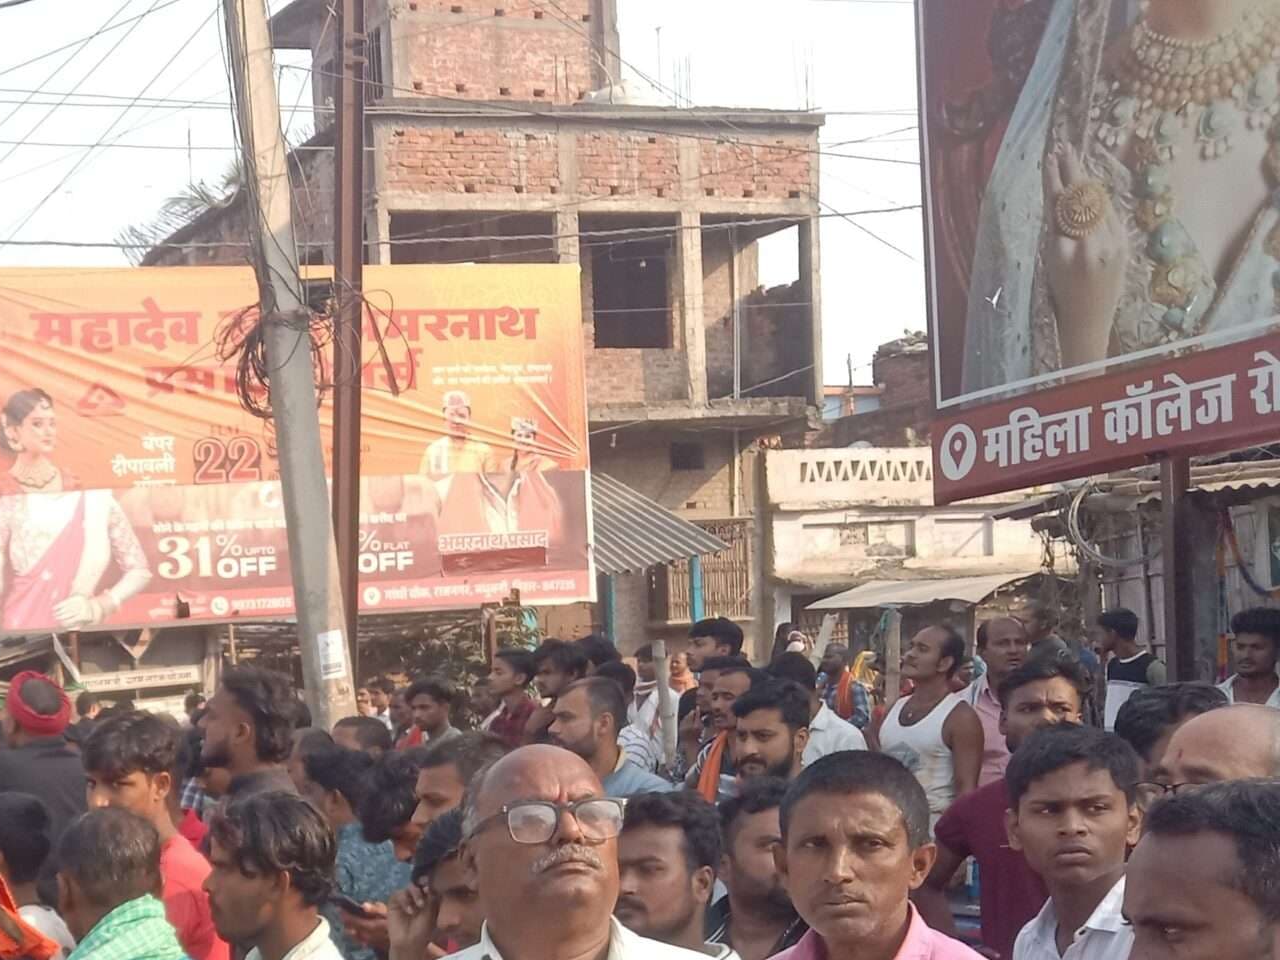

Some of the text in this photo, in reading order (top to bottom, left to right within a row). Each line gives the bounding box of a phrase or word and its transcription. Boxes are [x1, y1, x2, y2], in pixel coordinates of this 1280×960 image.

[30, 297, 202, 353] महादेव
[982, 350, 1280, 468] महिला कॉलेज रो
[193, 437, 262, 484] 22
[244, 547, 276, 556] UPTO
[383, 541, 410, 551] FLAT
[216, 556, 277, 579] OFF
[358, 551, 414, 573] OFF
